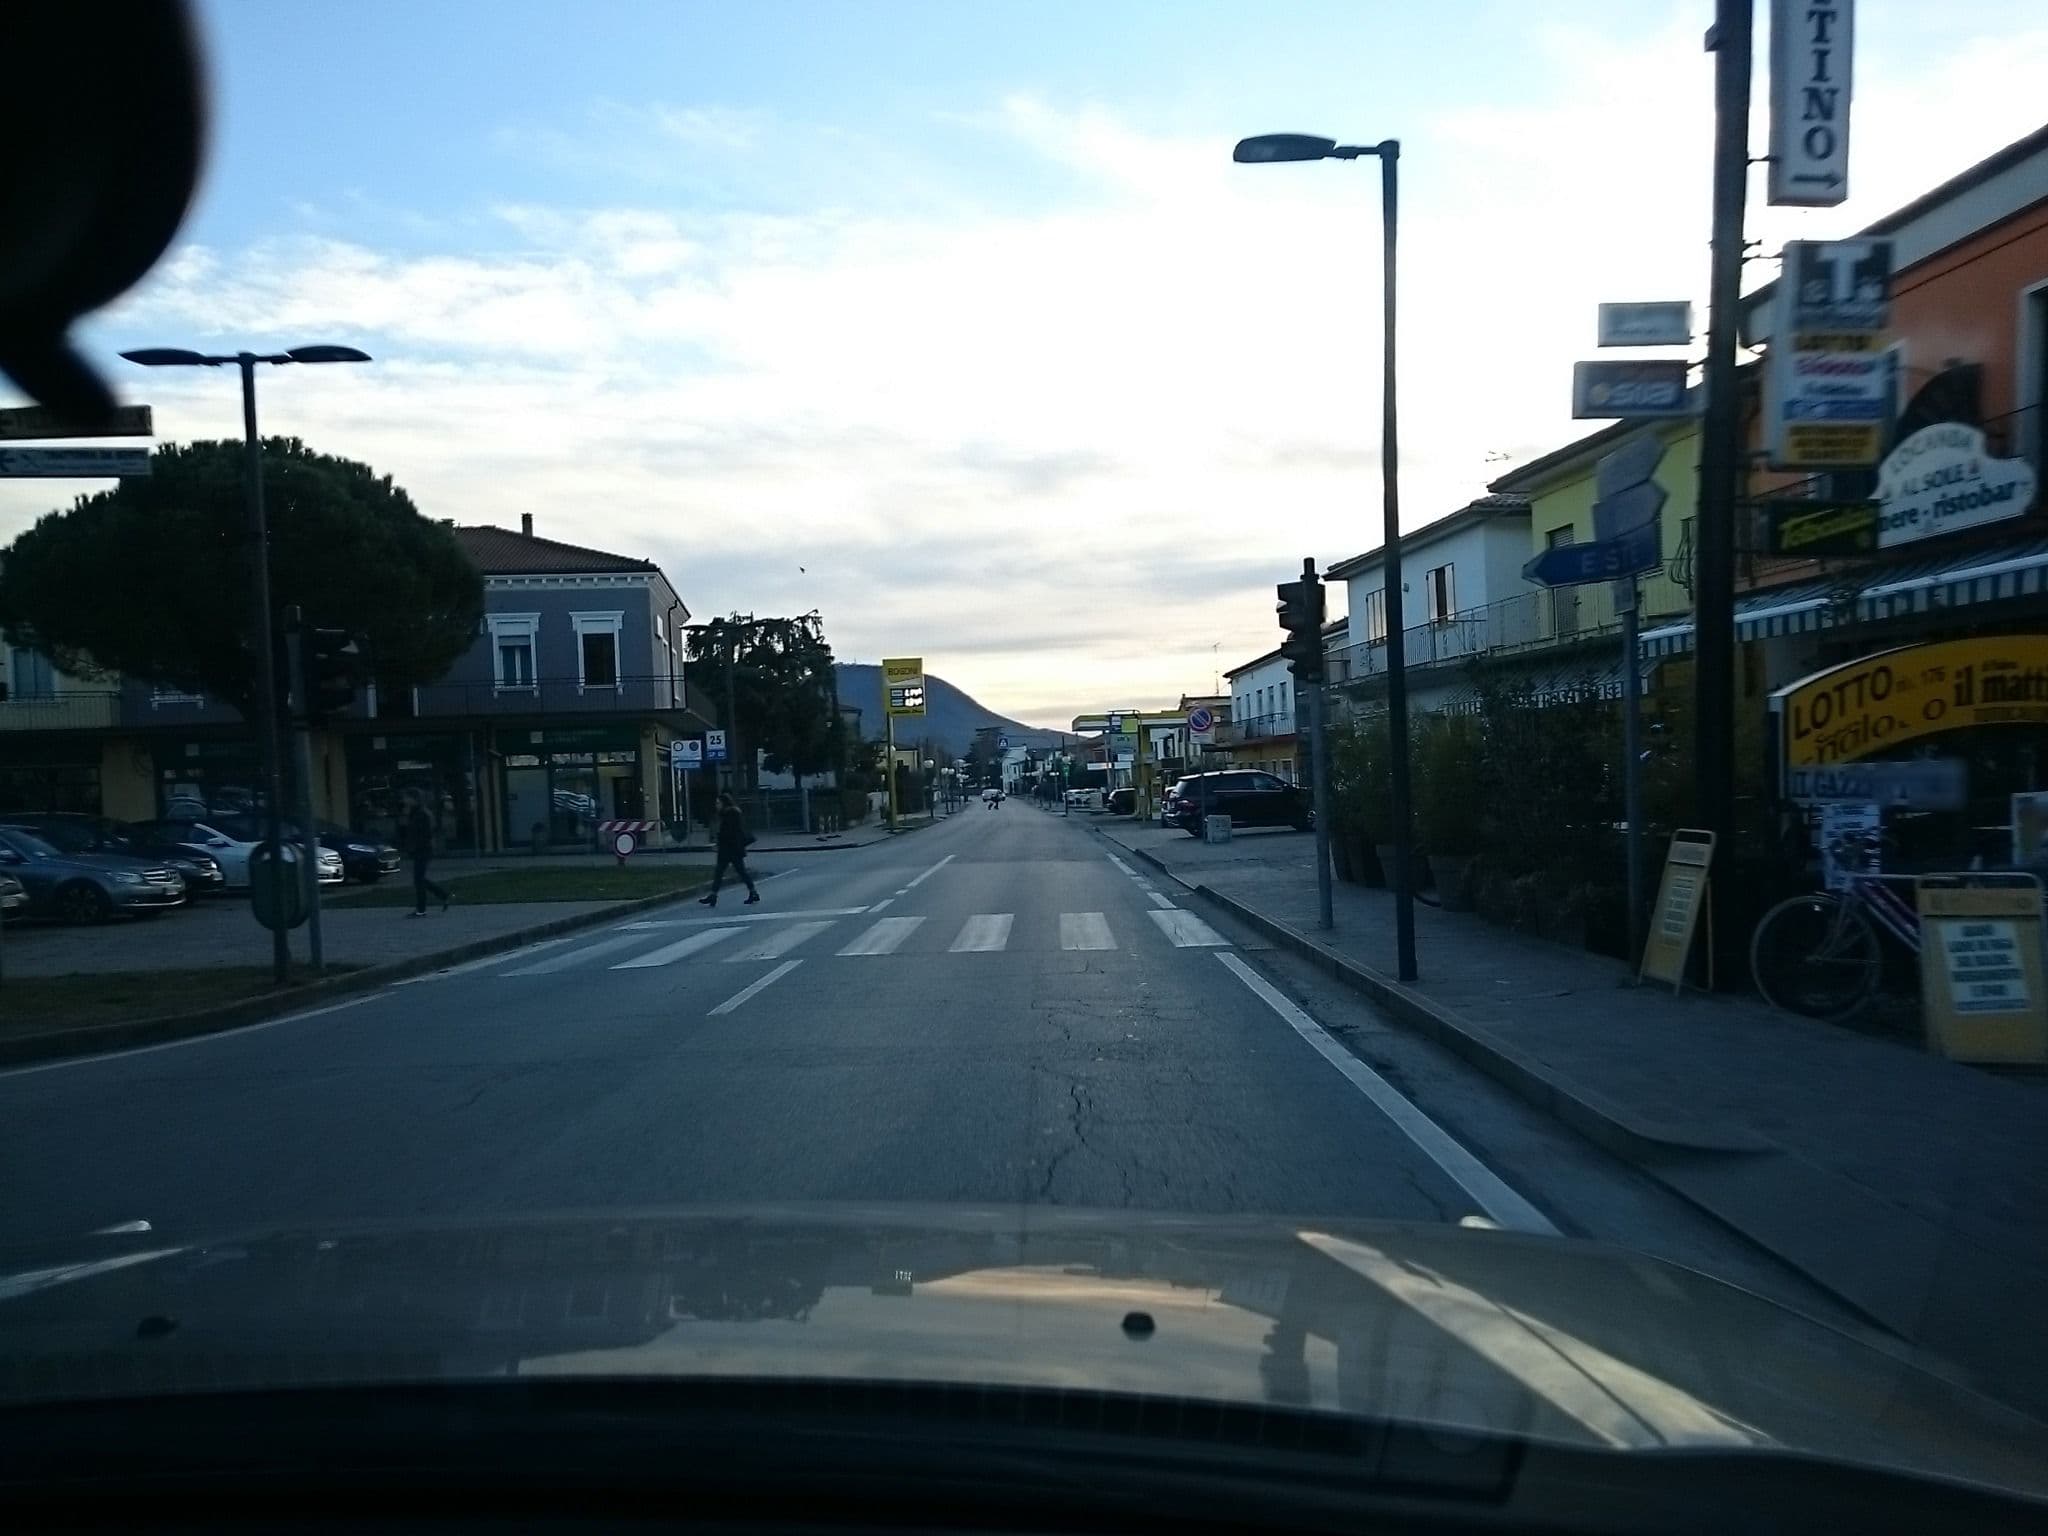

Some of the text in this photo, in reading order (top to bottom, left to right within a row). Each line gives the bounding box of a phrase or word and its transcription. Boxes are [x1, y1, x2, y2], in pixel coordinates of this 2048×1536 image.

[1801, 0, 1839, 161] TINO
[1932, 481, 2016, 518] ristobar
[1794, 665, 1894, 740] LOTTO
[709, 735, 722, 745] 25
